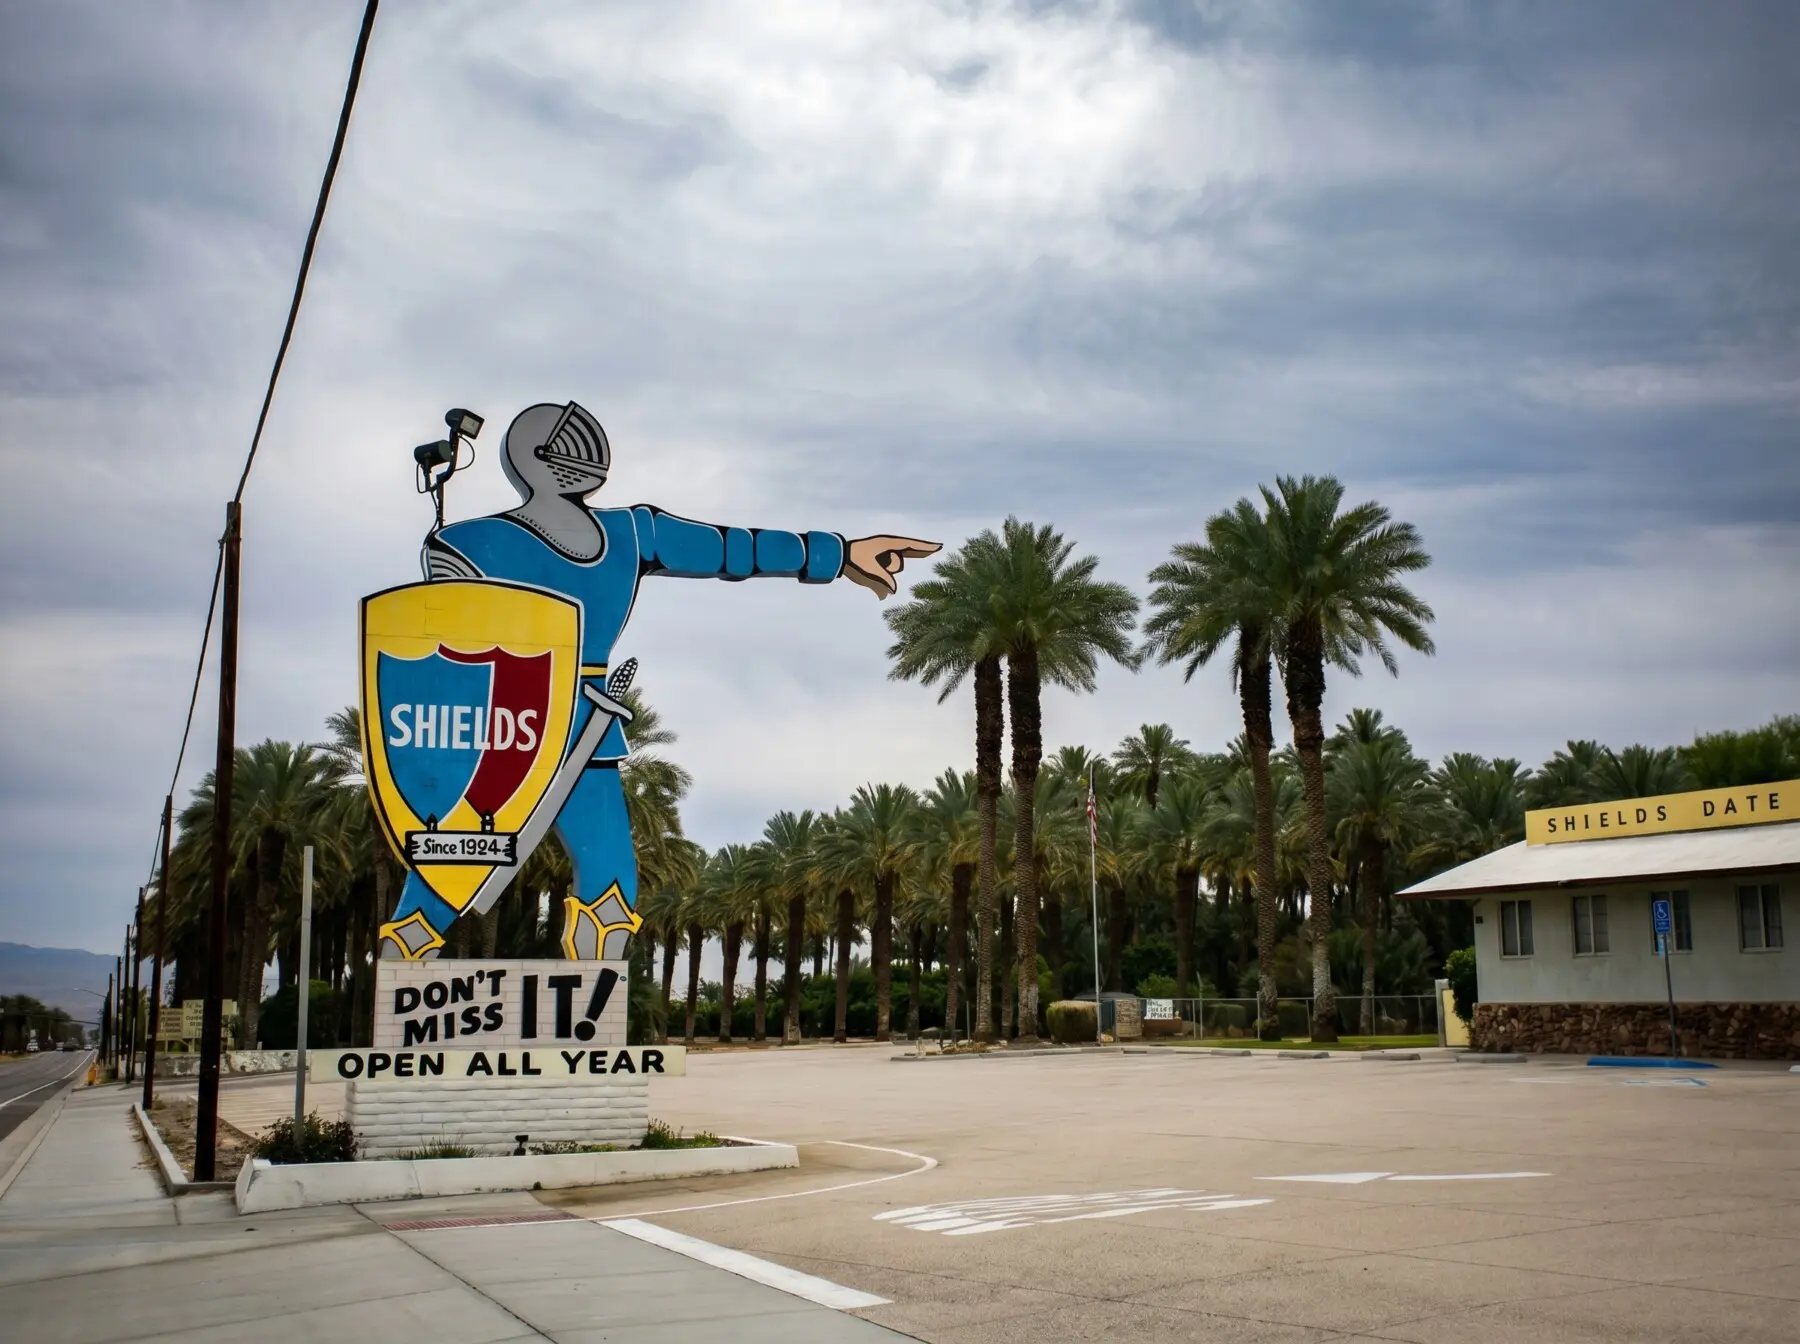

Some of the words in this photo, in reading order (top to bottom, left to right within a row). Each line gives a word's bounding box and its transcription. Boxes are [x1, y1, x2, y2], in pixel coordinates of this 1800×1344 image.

[389, 703, 537, 752] SHIELDS
[1547, 805, 1668, 833] SHIELDS
[1702, 792, 1780, 817] DATE
[422, 838, 457, 855] Since
[459, 838, 502, 856] 1924
[394, 969, 507, 1015] DON'T
[520, 967, 619, 1042] IT!
[403, 1002, 504, 1048] MISS
[337, 1052, 445, 1080] OPEN
[466, 1051, 542, 1077] ALL
[560, 1049, 665, 1075] YEAR
